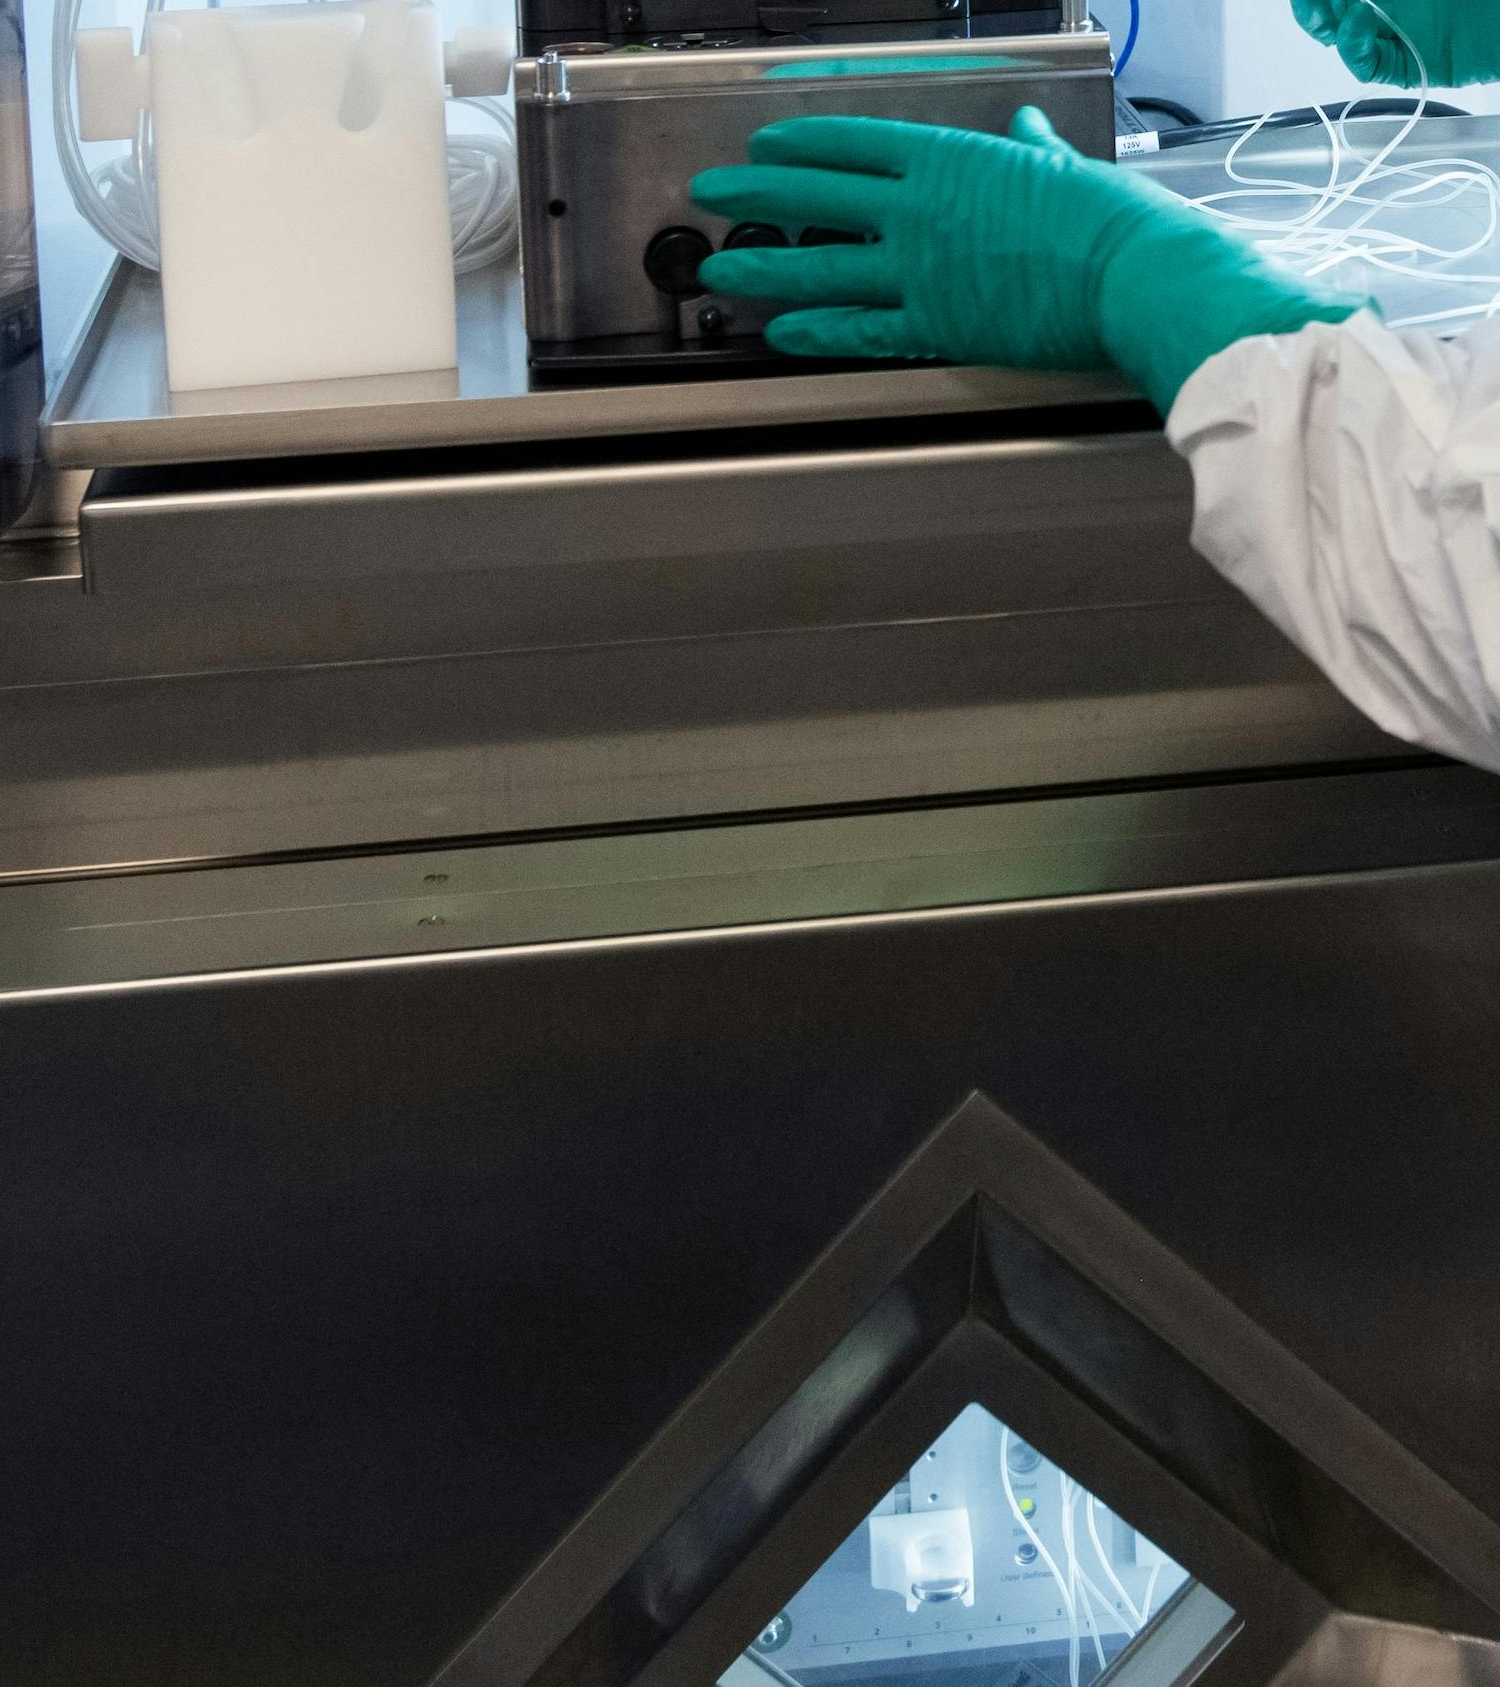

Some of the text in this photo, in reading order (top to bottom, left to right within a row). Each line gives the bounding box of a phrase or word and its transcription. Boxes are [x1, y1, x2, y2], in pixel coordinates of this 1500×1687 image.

[1122, 141, 1141, 150] 125V
[874, 1627, 881, 1636] 2
[935, 1621, 941, 1630] 3
[843, 1646, 851, 1655] 7
[1025, 1626, 1037, 1635] 10
